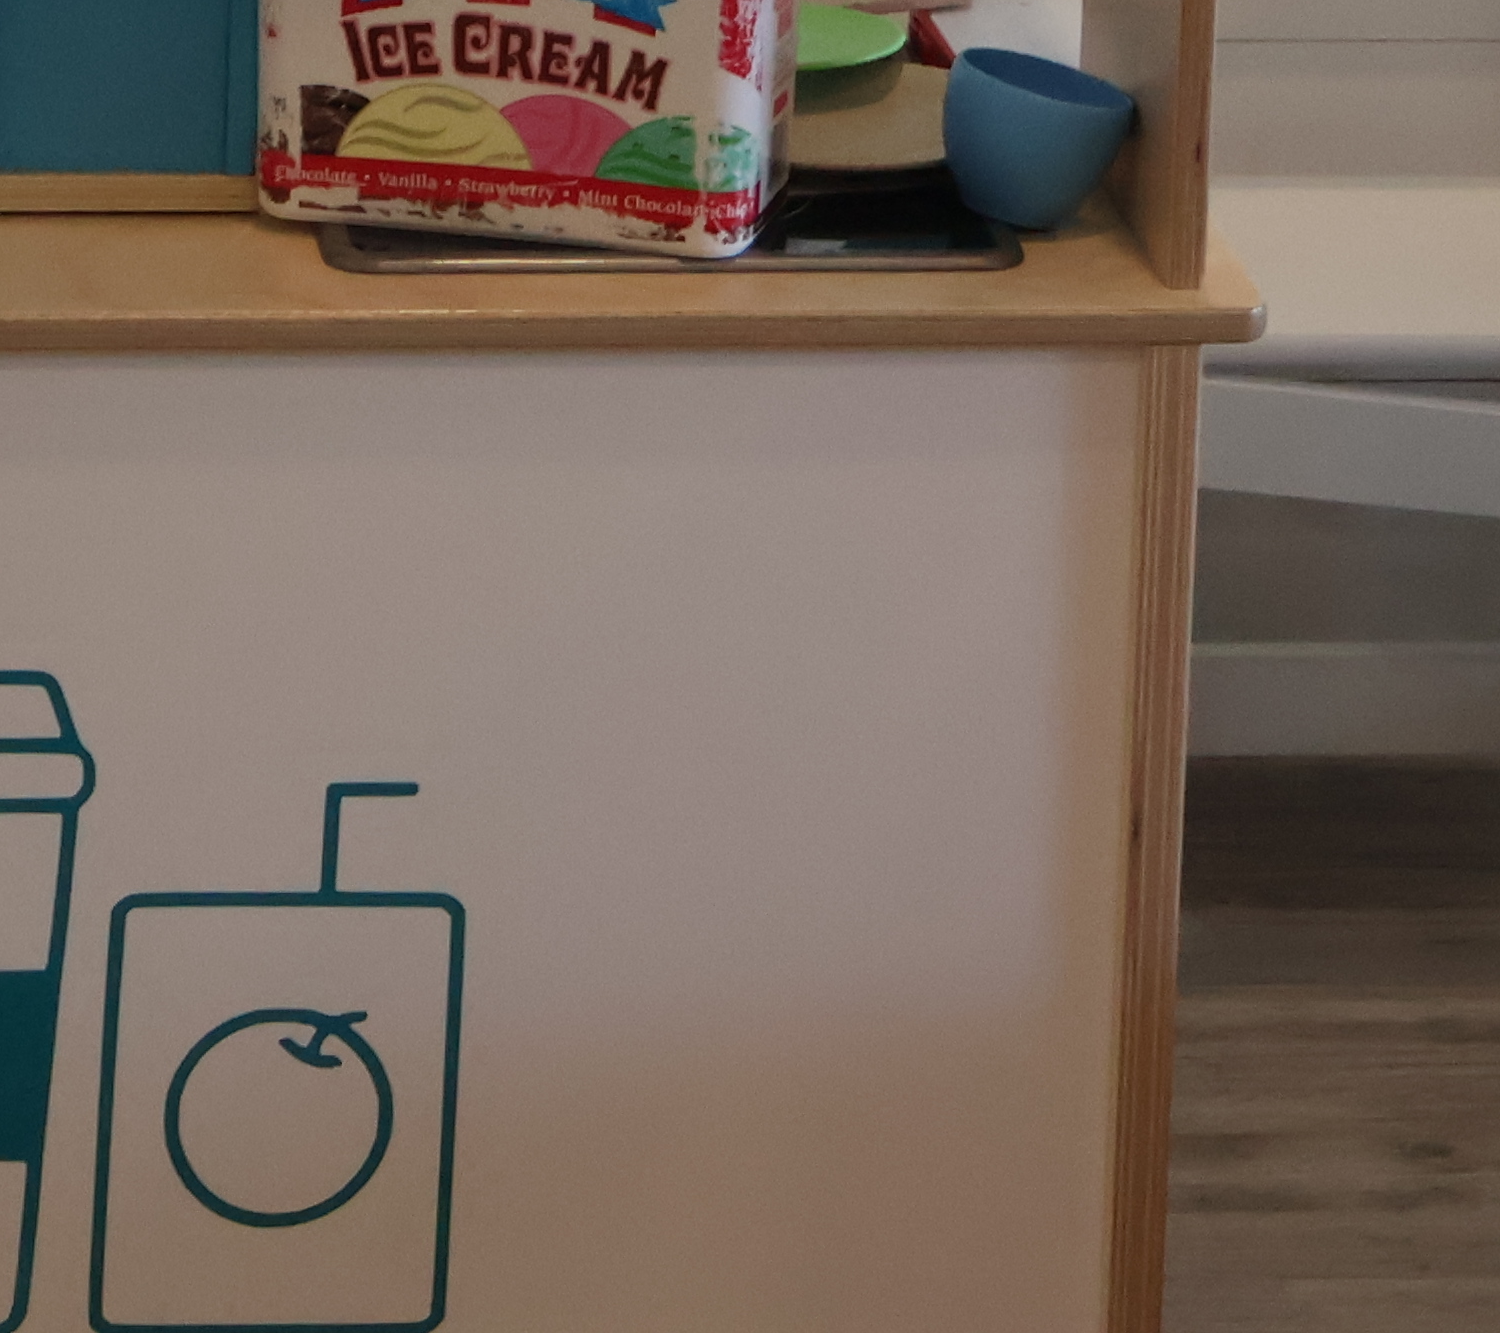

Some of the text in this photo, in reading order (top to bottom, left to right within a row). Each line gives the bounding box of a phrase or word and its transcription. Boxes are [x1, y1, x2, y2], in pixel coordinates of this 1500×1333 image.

[341, 11, 670, 112] ICE CREAM
[274, 164, 357, 186] Chocolate
[378, 170, 439, 191] Vanilla
[459, 176, 556, 203] Strawberry
[577, 189, 618, 208] Mint
